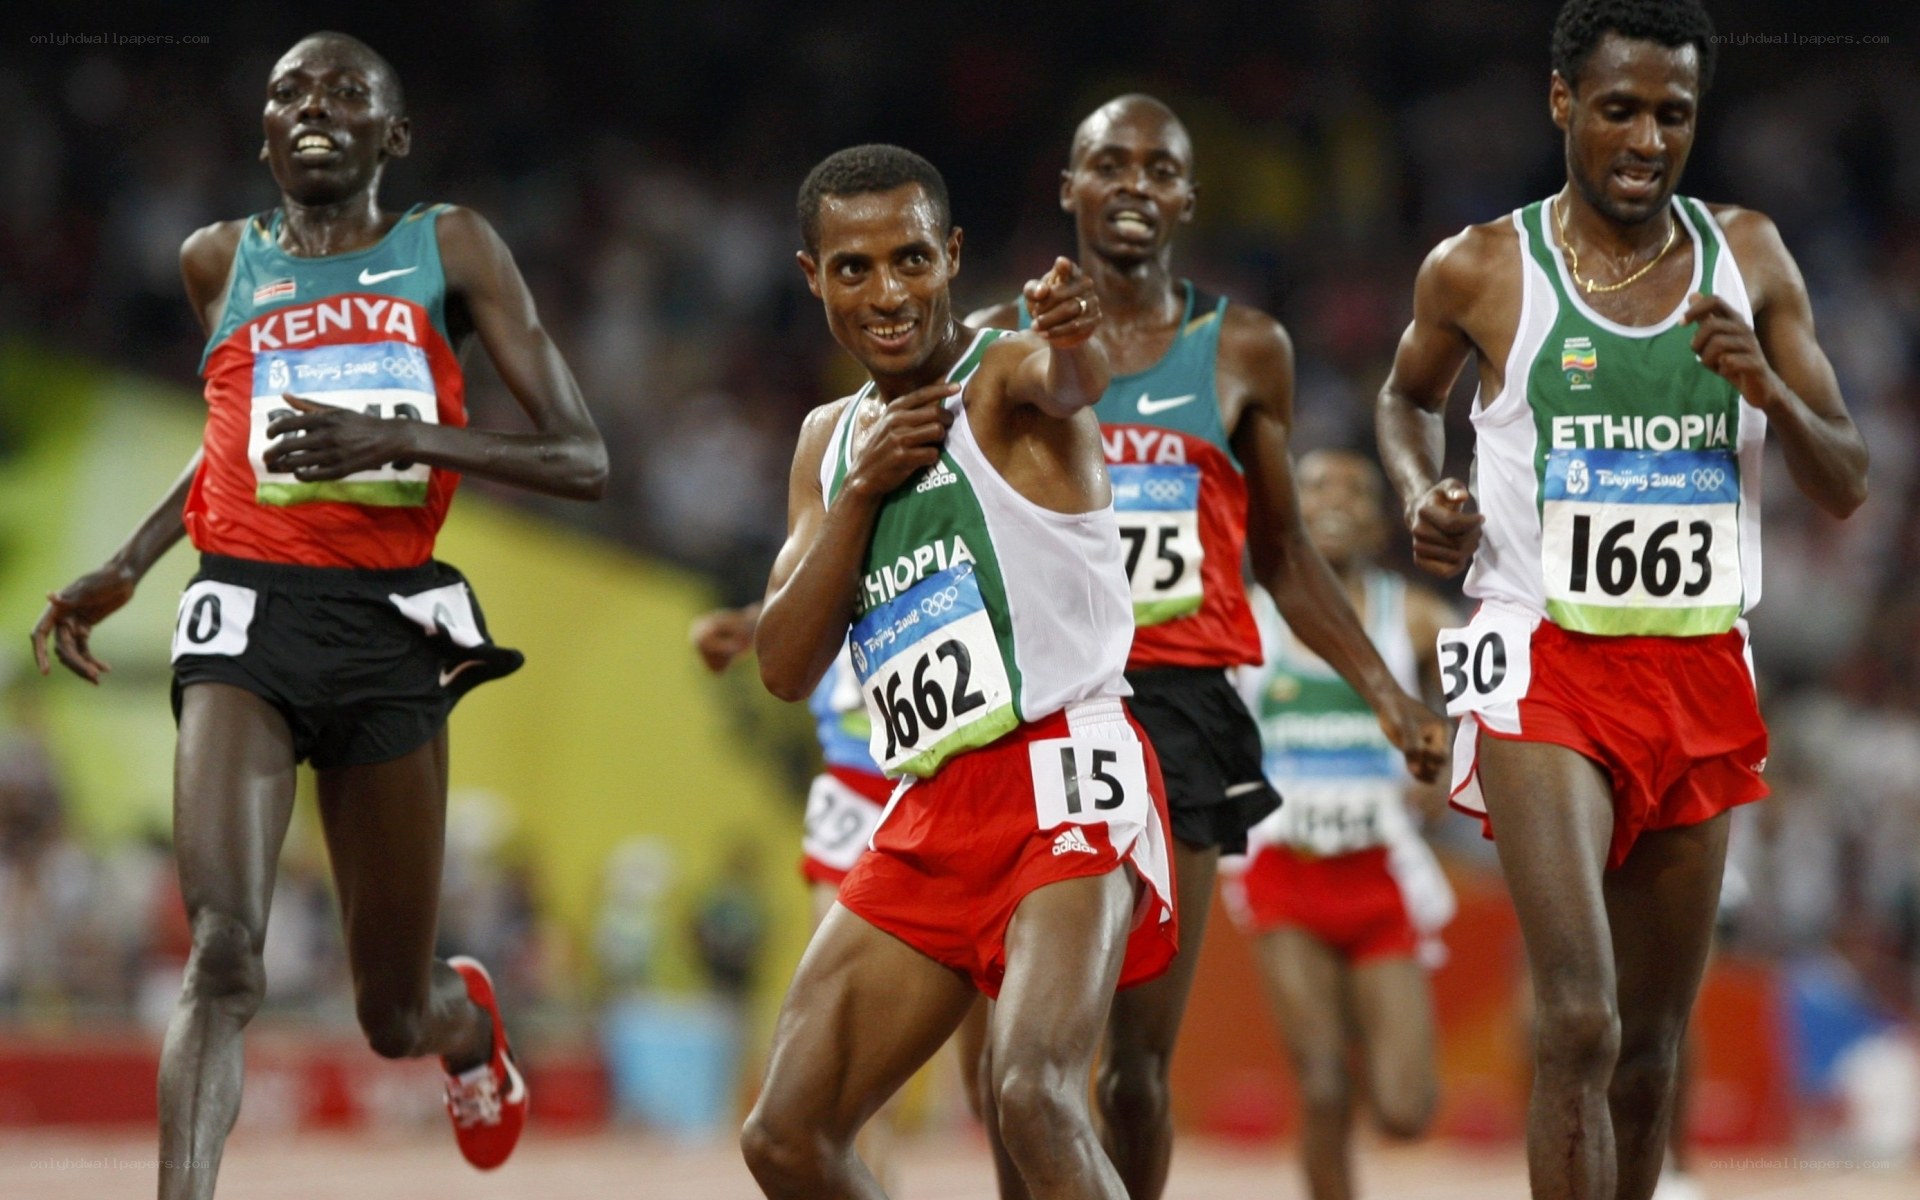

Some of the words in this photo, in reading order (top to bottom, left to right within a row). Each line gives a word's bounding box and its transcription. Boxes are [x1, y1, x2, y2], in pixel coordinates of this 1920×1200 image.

[250, 298, 417, 351] KENYA
[1552, 412, 1729, 449] ETHIOPIA
[916, 472, 957, 494] adidas
[1596, 469, 1648, 491] Beijing
[1650, 472, 1686, 488] 2008
[860, 534, 977, 610] HIOPIA
[1569, 514, 1713, 597] 1663
[1440, 632, 1507, 700] 30
[872, 639, 987, 761] 1662
[1060, 747, 1125, 814] 15
[1052, 840, 1098, 856] adidas
